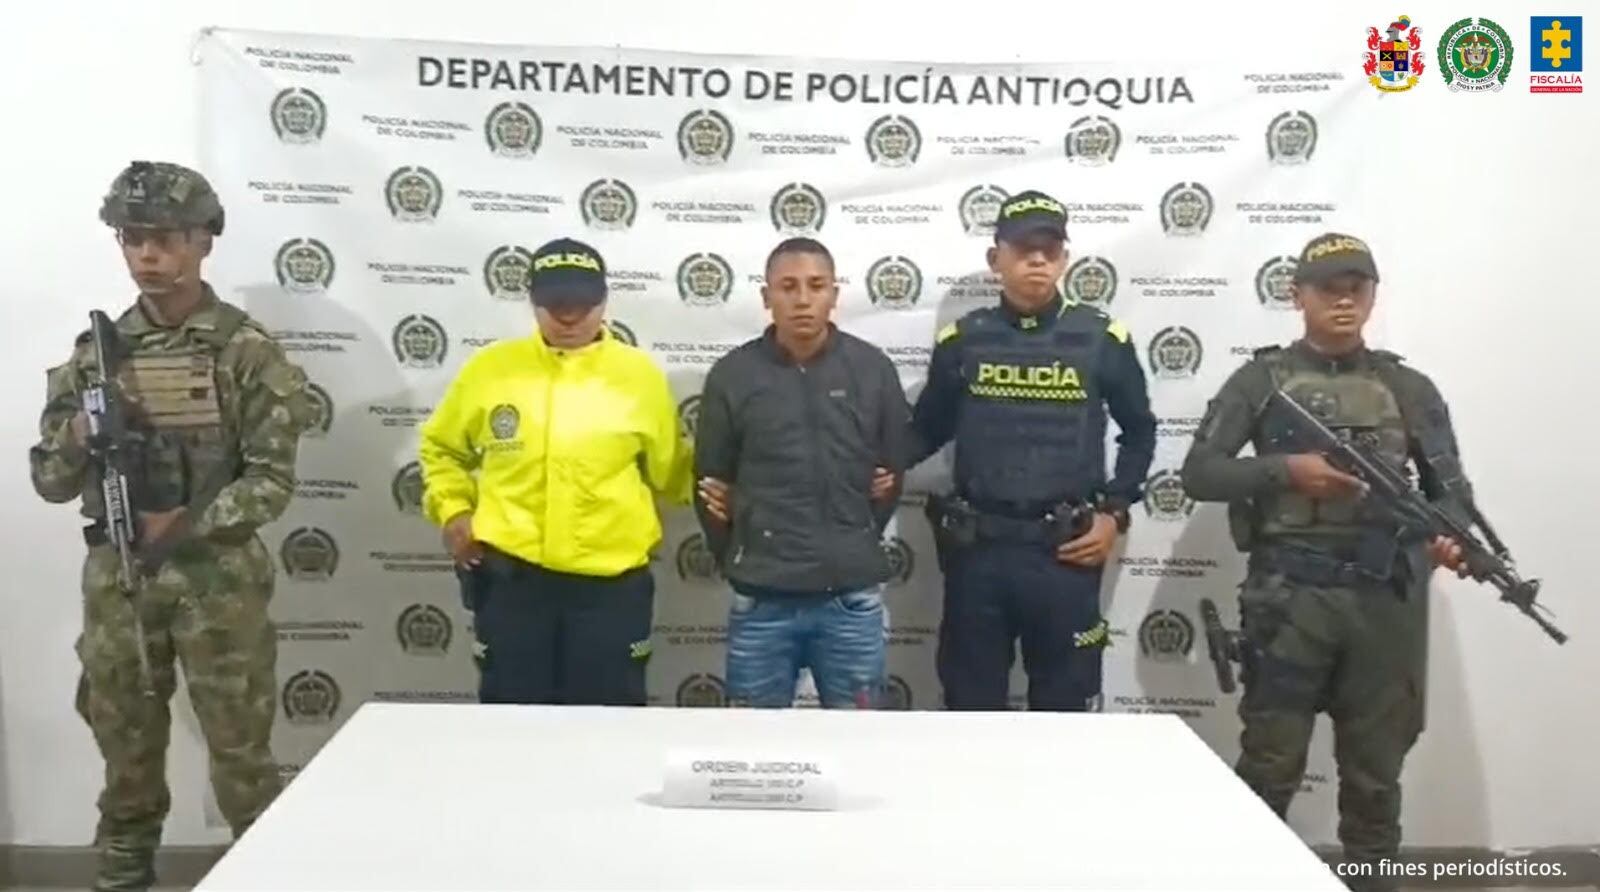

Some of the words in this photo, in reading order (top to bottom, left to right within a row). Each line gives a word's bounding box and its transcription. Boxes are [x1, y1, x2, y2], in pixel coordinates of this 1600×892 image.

[418, 56, 731, 98] DEPARTAMENTO
[745, 70, 793, 100] DE
[806, 67, 958, 103] POLICÍA
[967, 76, 1194, 109] ANTIOQUIA
[979, 361, 1079, 387] POLICÍA
